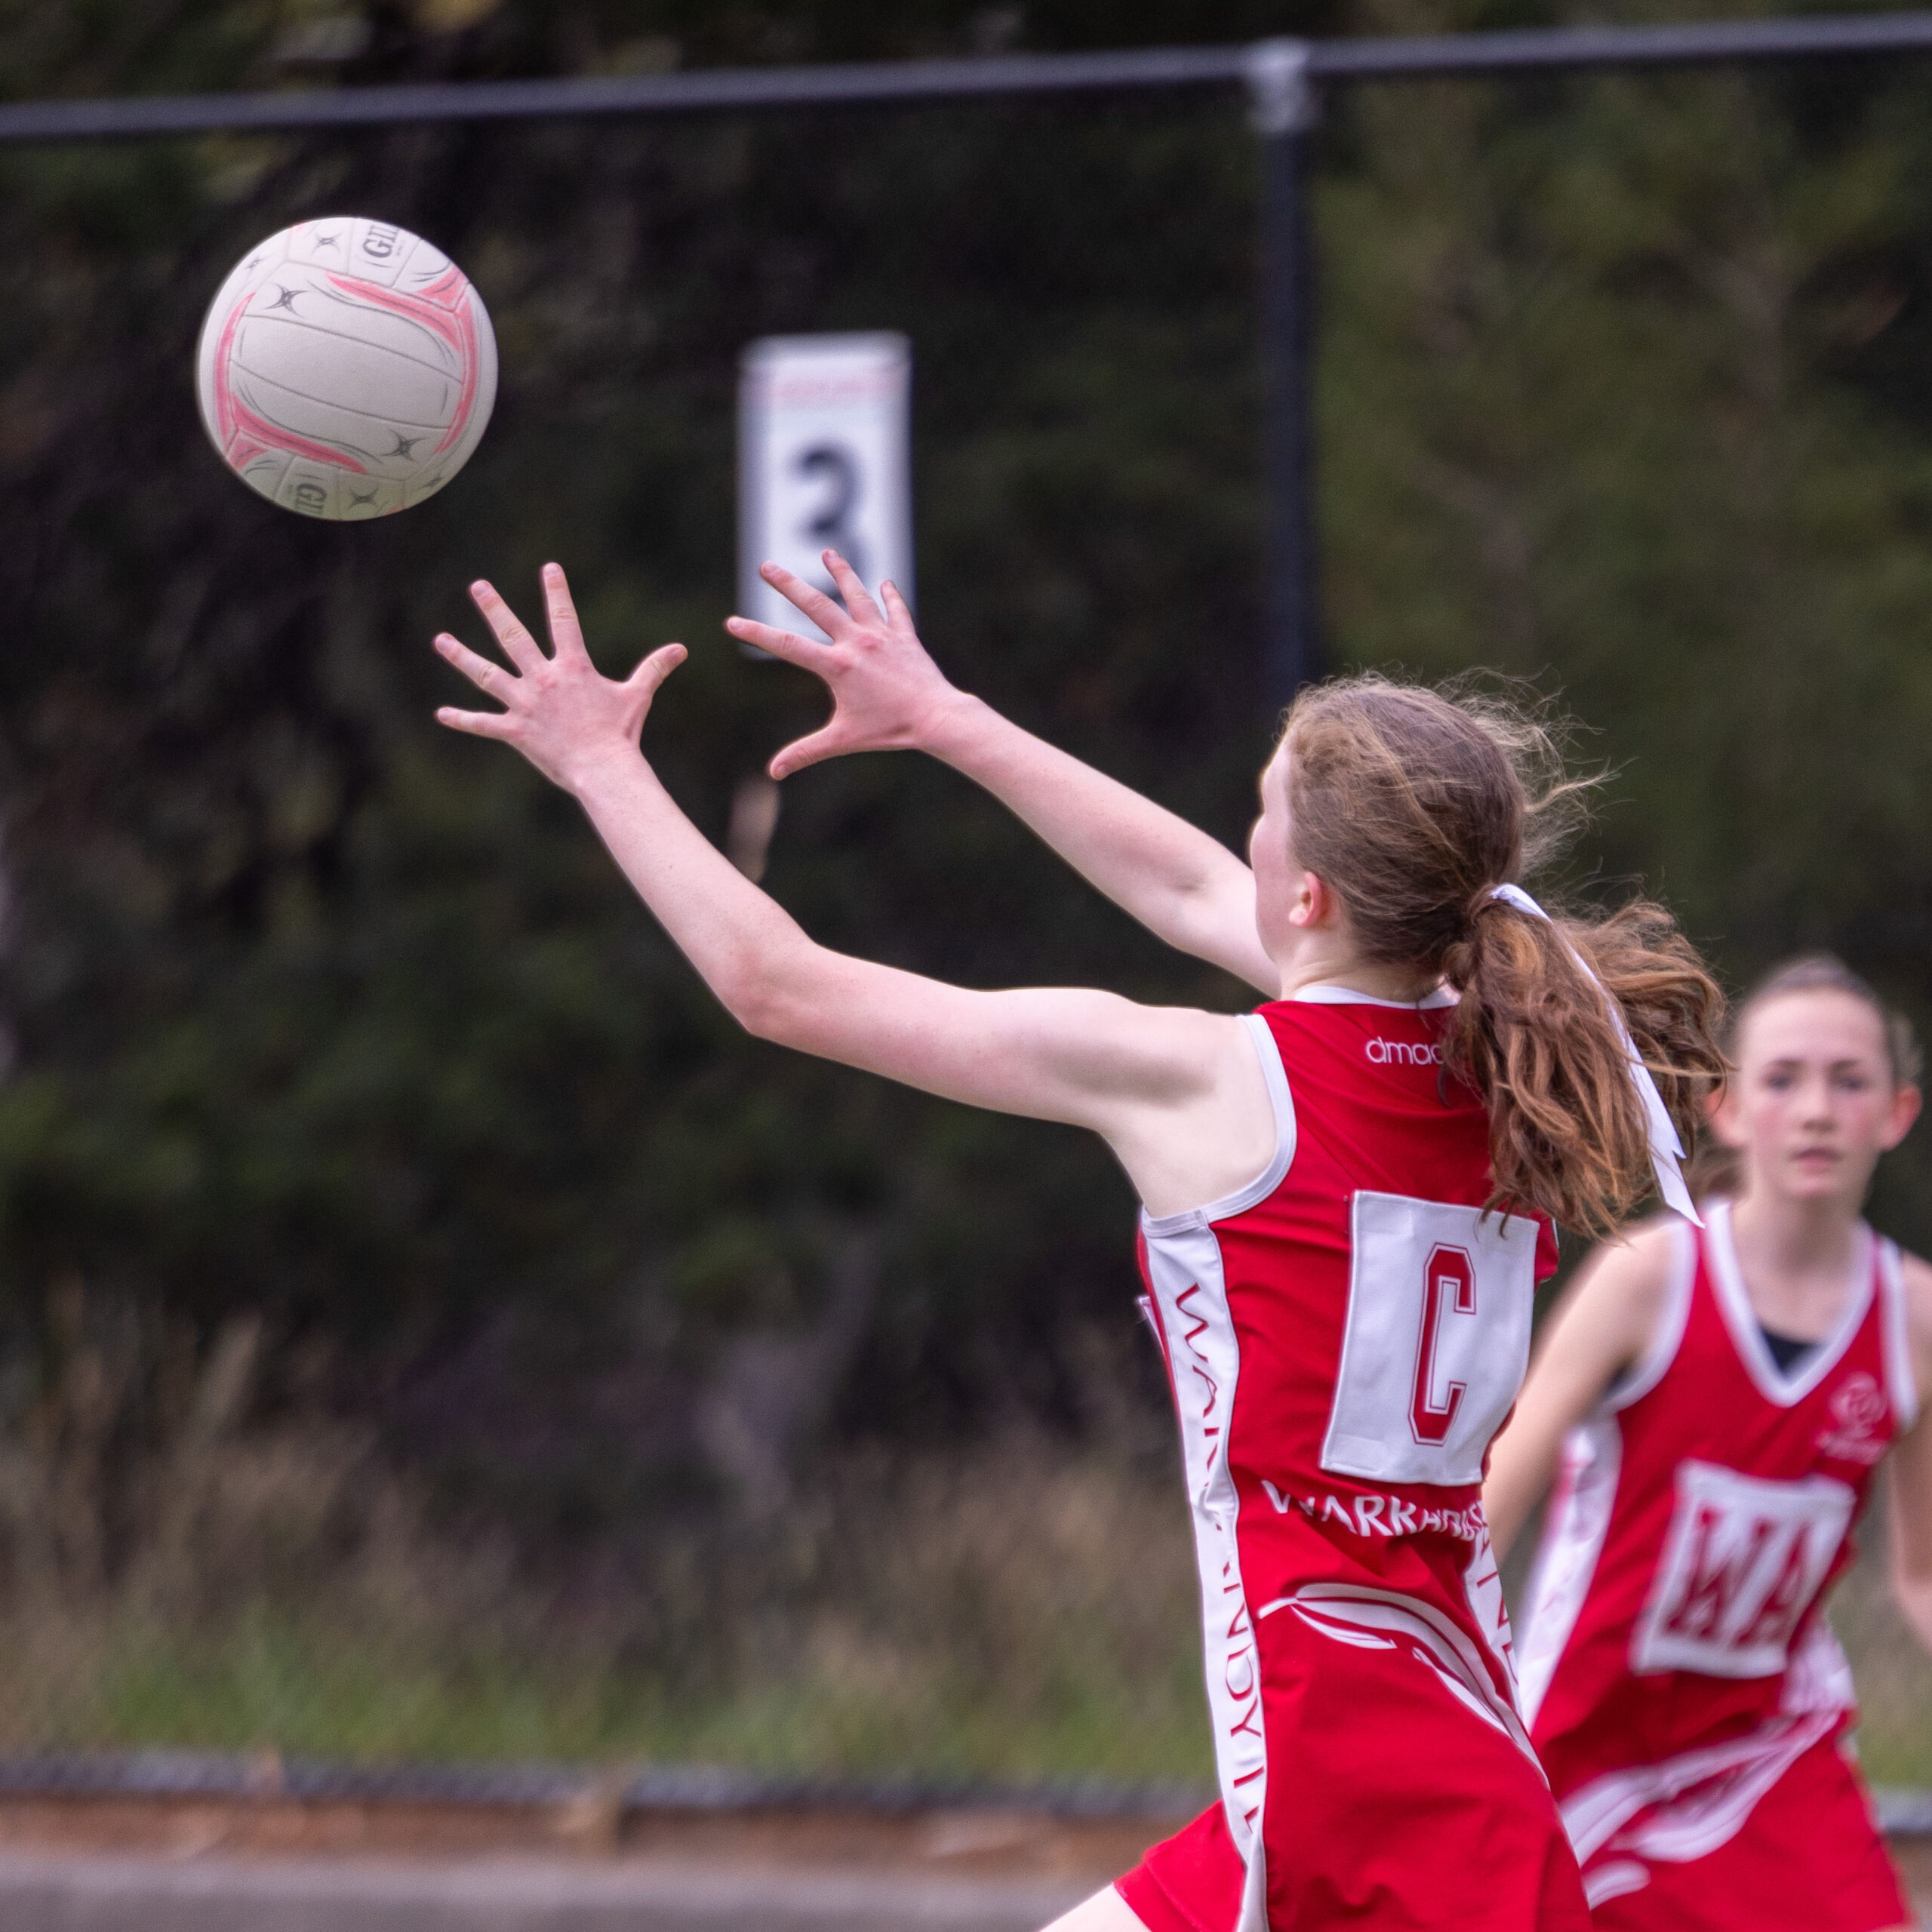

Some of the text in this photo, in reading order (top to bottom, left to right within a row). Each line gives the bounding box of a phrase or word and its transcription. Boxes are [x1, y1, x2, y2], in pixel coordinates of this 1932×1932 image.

[791, 438, 872, 613] 3
[1408, 1241, 1476, 1447] C
[1663, 1504, 1813, 1645] WA
